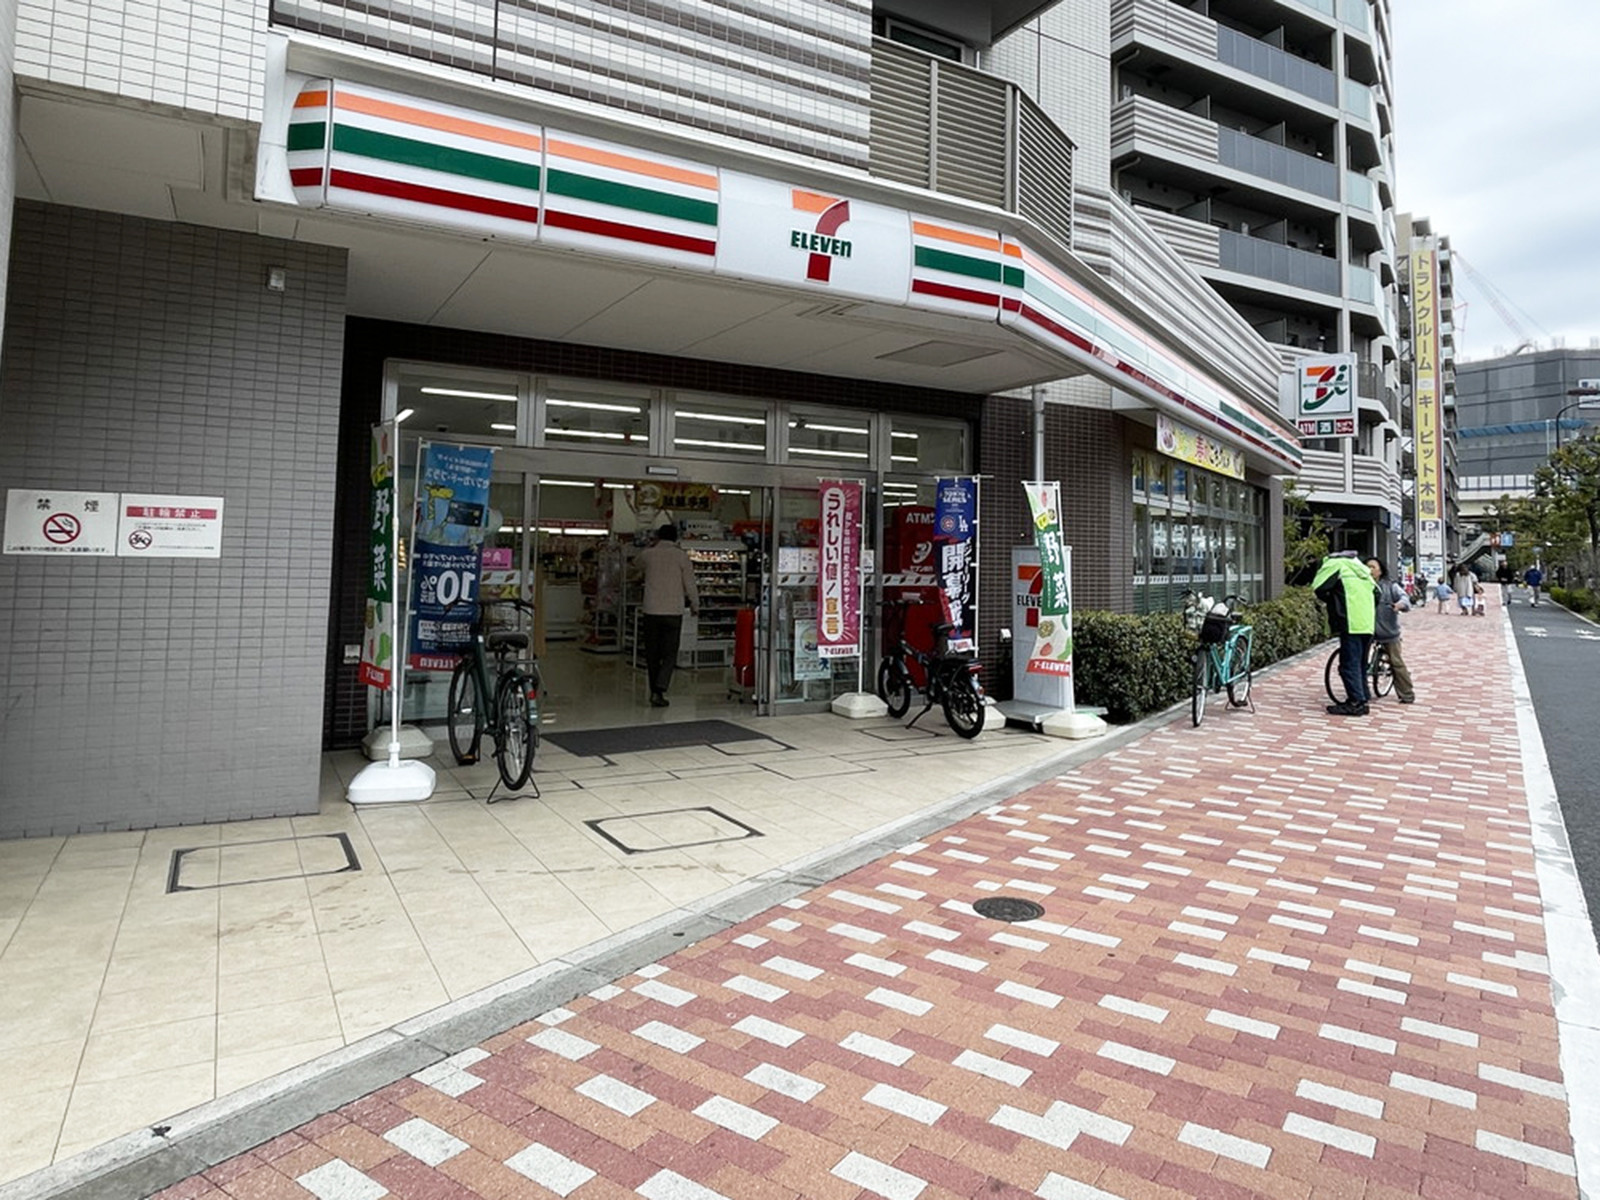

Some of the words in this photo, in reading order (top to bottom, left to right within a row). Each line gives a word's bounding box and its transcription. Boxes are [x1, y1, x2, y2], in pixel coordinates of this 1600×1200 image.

[1416, 255, 1432, 371] トランクルーム
